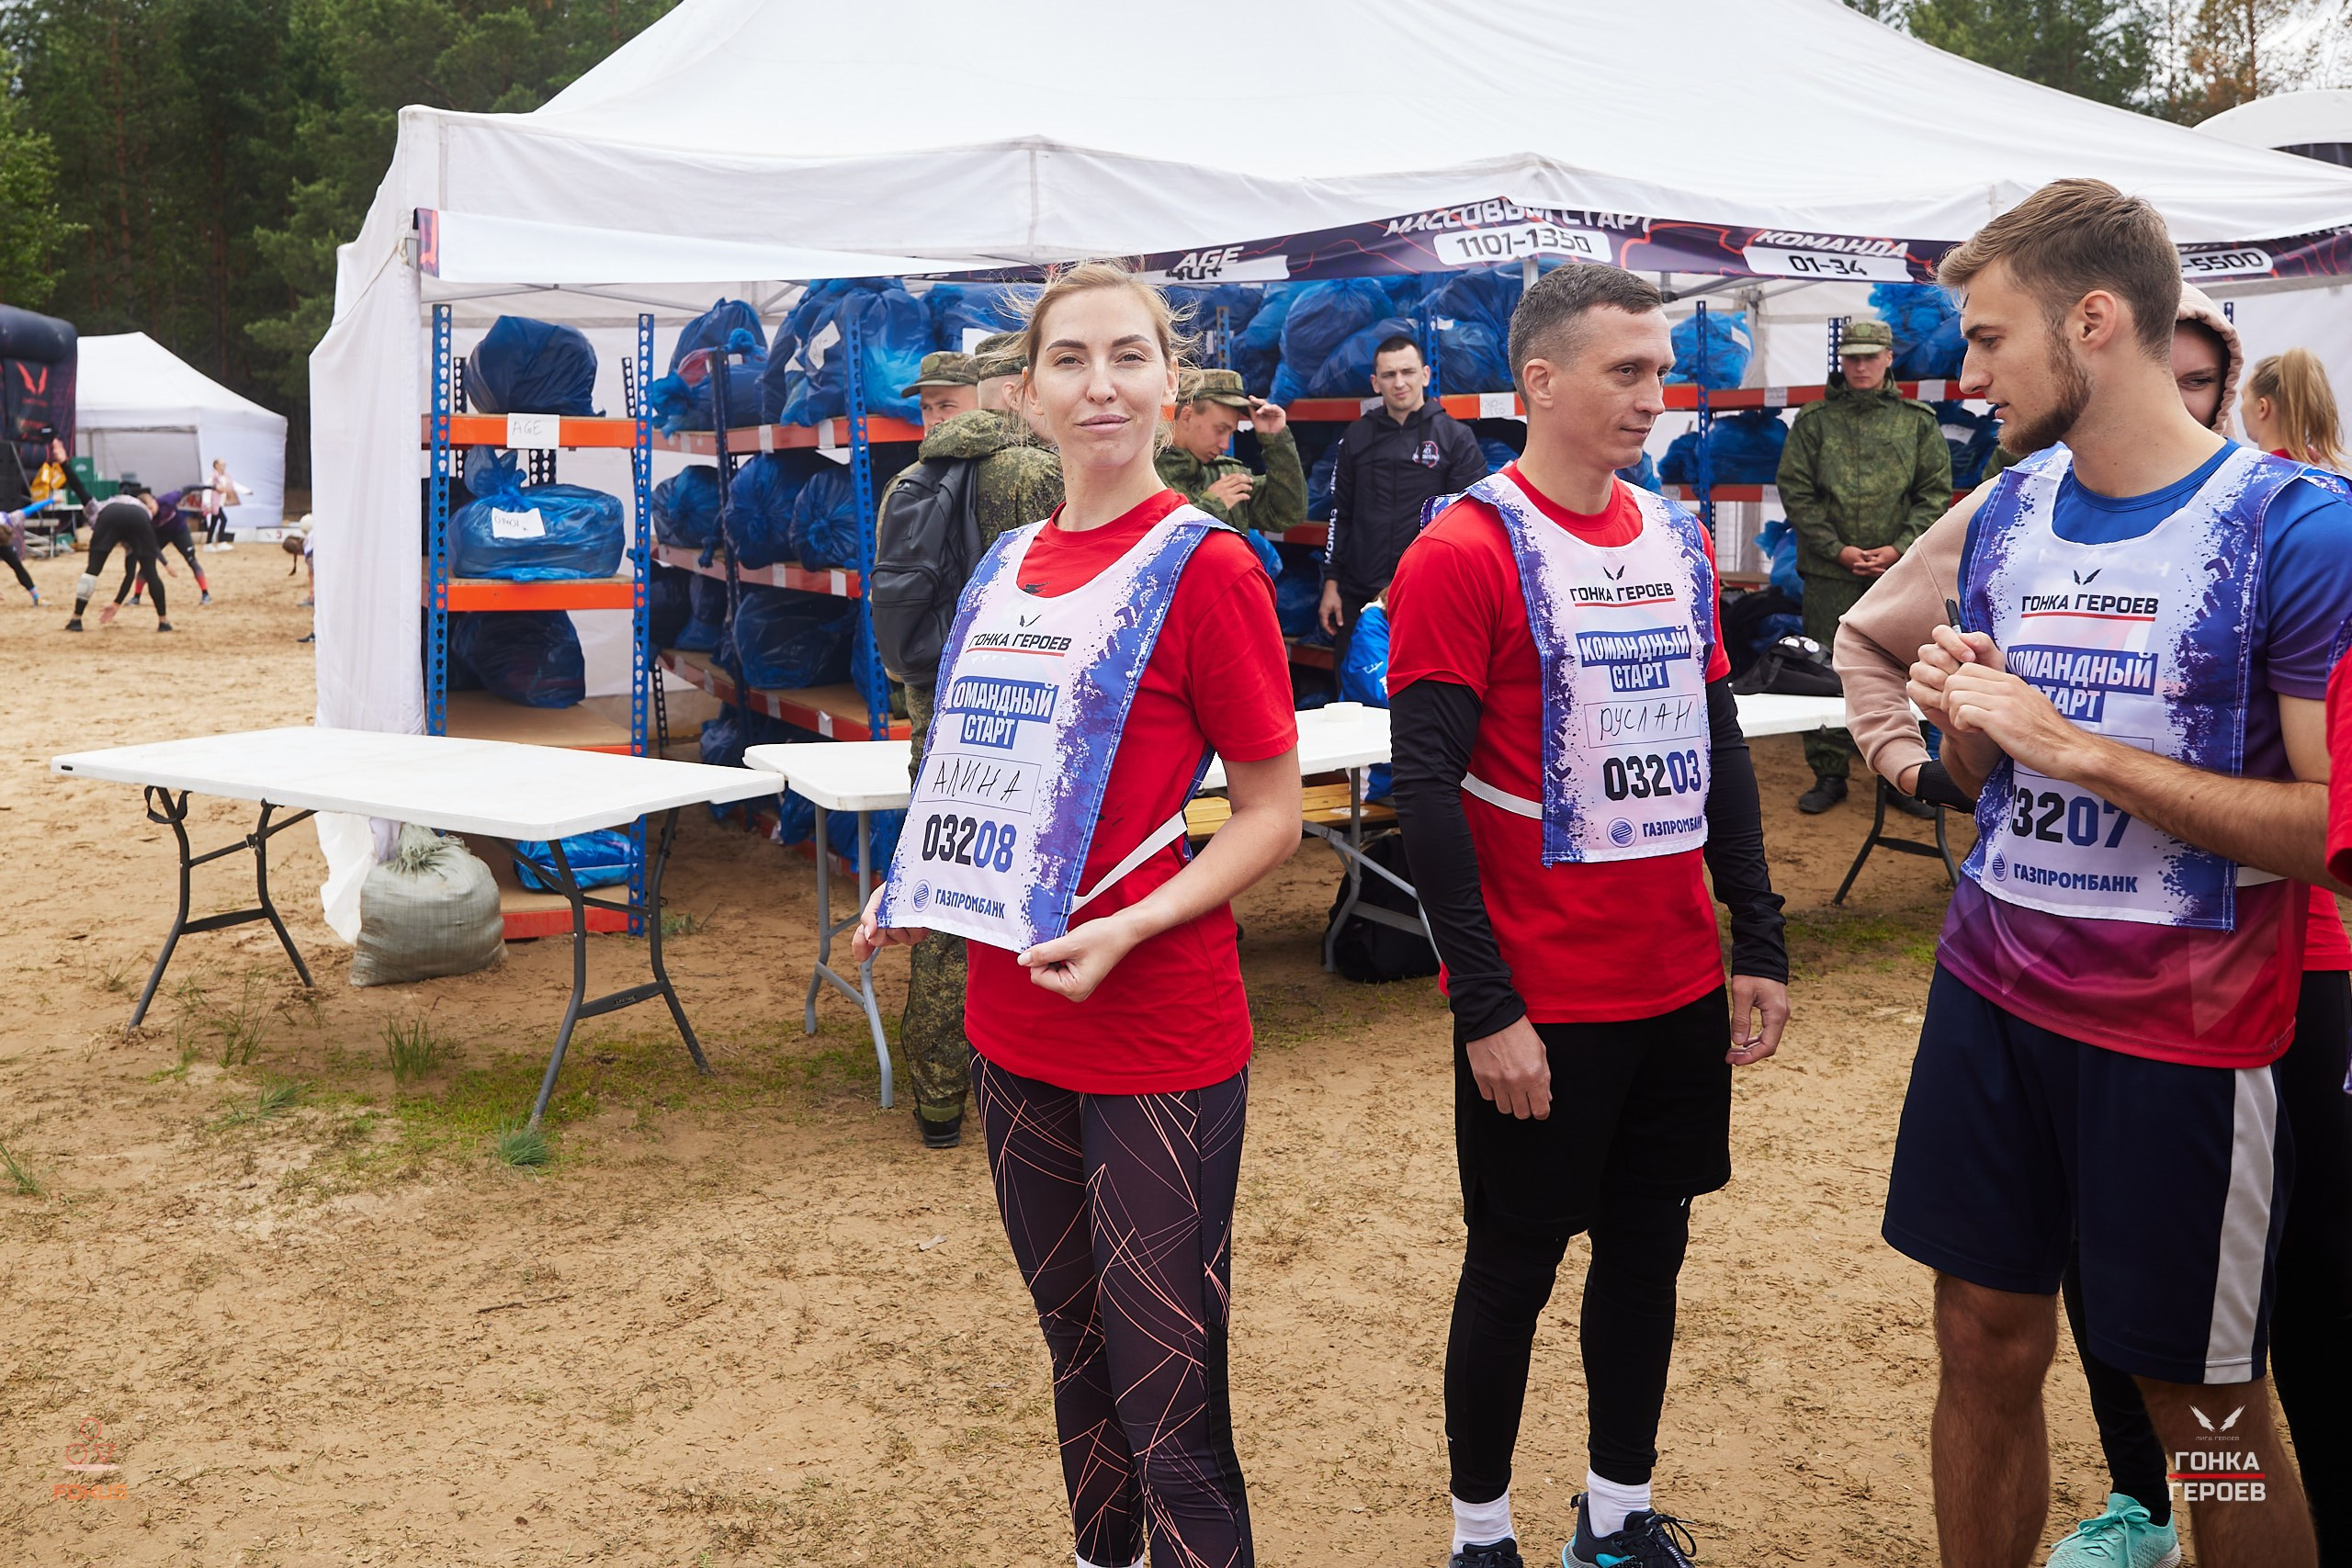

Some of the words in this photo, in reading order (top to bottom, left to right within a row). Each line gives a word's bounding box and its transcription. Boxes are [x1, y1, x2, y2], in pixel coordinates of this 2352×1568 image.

[1173, 245, 1245, 270] AGE
[1753, 229, 1910, 259] КОМАНДА
[1788, 254, 1868, 277] 01-34
[2181, 252, 2264, 273] -5500
[512, 419, 543, 435] AGE
[1570, 586, 1614, 603] ГОНКА
[1616, 582, 1675, 602] ГЕРОЕВ
[2021, 593, 2069, 612] ГОНКА
[2075, 592, 2160, 615] ГЕРОЕВ
[968, 634, 1010, 648] ГОНКА
[1012, 633, 1073, 651] ГЕРОЕВ
[1579, 625, 1691, 663] КОМАНДНЫЙ
[1611, 660, 1667, 690] СТАРТ
[2007, 650, 2154, 689] КОМАНДНЫЙ
[2029, 683, 2101, 718] ТАРТ
[964, 714, 1016, 746] СТАРТ
[1600, 700, 1693, 741] РУСЛАН
[932, 759, 1023, 803] АЛИНА
[1602, 749, 1702, 802] 03203
[2007, 784, 2132, 849] 3207
[922, 813, 1018, 874] 03208
[2013, 863, 2139, 894] ГАЗПРОМБАНК
[935, 888, 1005, 919] ГАЗПРОМБАНК
